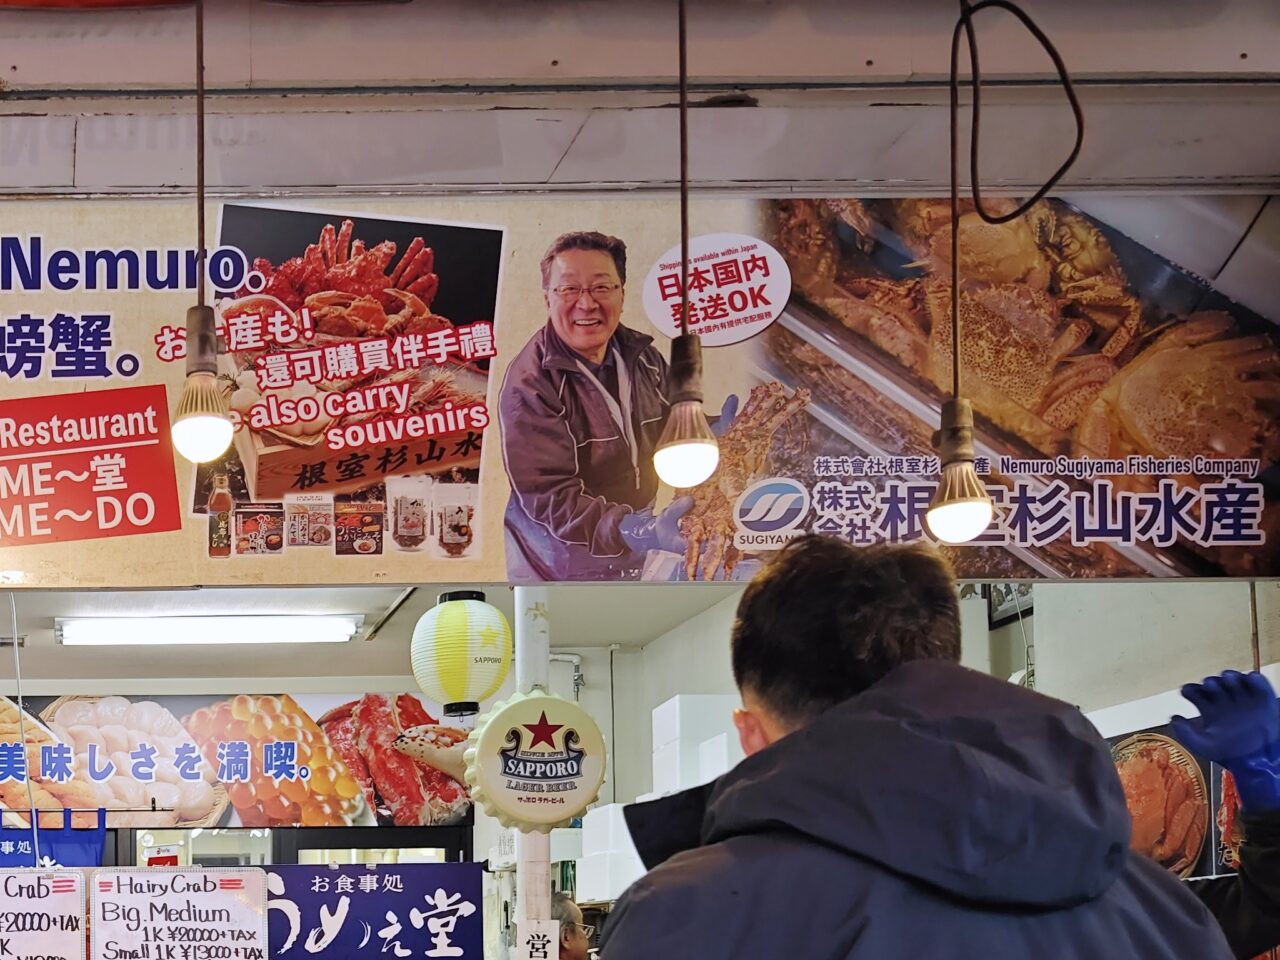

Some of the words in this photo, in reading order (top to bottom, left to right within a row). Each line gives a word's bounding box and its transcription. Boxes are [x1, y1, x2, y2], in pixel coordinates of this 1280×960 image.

[1, 237, 264, 291] Nemuro.
[693, 251, 720, 263] available
[720, 246, 739, 257] within
[741, 243, 758, 253] Japan
[657, 254, 770, 301] 日本国内
[671, 284, 771, 329] 発送OK
[156, 308, 314, 360] お産も!
[258, 324, 495, 388] 還可購買伴手禮
[251, 396, 318, 428] also
[326, 383, 410, 417] carry
[0, 405, 159, 448] Restaurant
[328, 403, 488, 449] souvenirs
[816, 457, 883, 474] 株式會社
[887, 457, 990, 474] 根室杉產
[1001, 458, 1054, 473] Nemuro
[1056, 457, 1124, 478] Sugiyama
[1128, 457, 1190, 473] Fisheries
[1193, 457, 1258, 478] Company
[817, 485, 872, 511] 株式
[879, 483, 1261, 543] 根杉山水産
[473, 656, 502, 665] SAPPORO
[505, 759, 578, 777] SAPPORO
[506, 779, 544, 793] LAGER
[546, 781, 578, 793] BEER
[4, 875, 50, 899] Crab
[116, 876, 168, 897] Hairy
[170, 874, 217, 893] Crab
[310, 874, 404, 893] お食事処
[102, 941, 150, 960] Small
